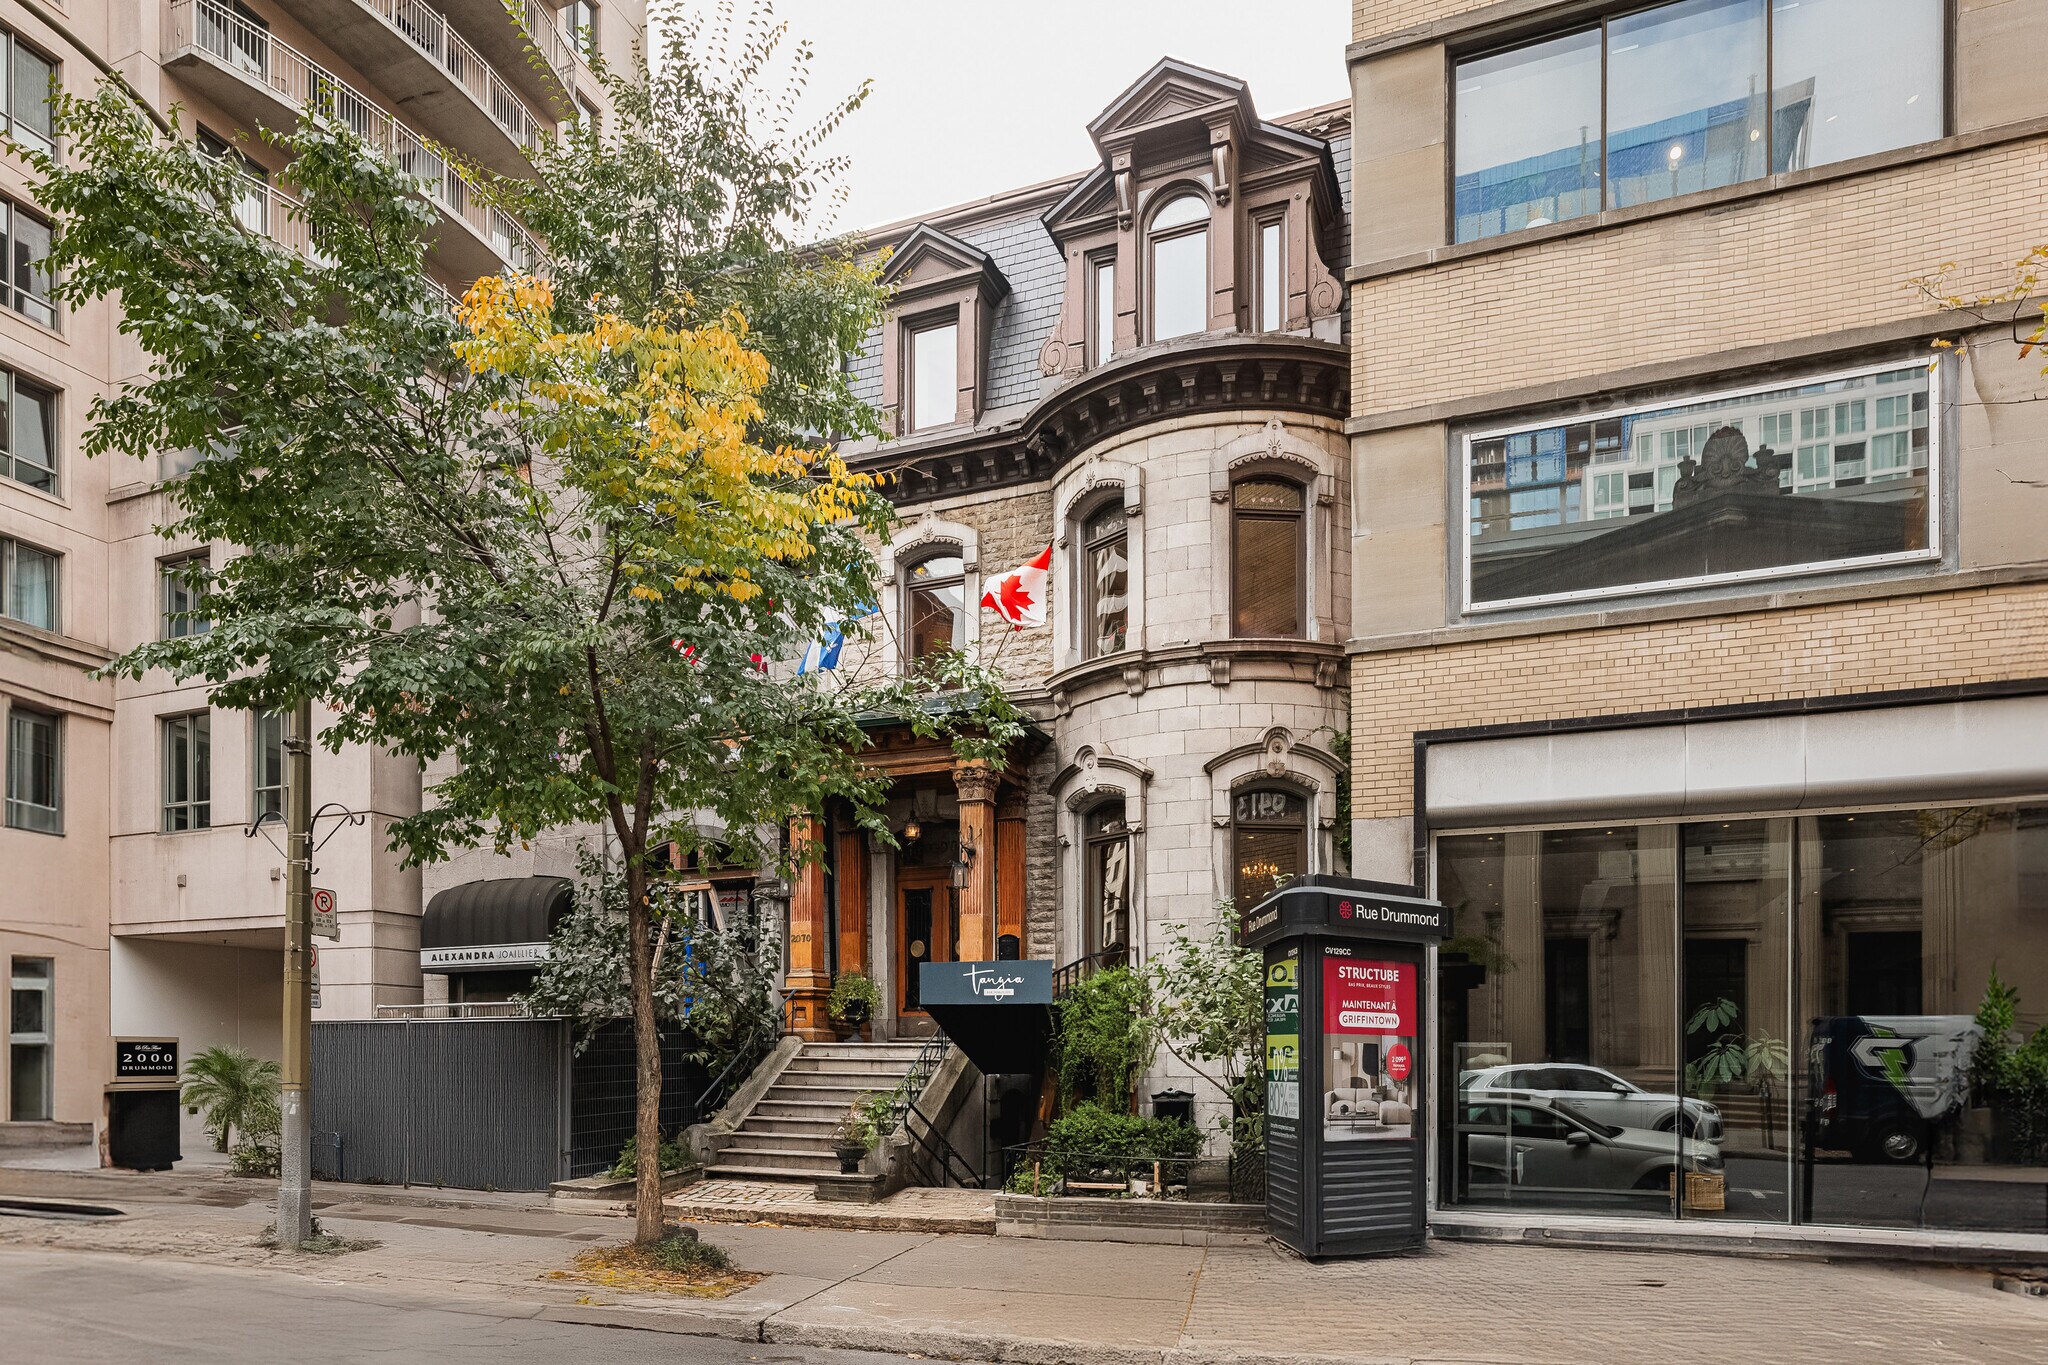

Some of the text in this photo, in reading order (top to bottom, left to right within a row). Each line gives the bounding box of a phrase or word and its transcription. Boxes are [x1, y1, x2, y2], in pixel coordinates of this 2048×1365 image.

[1356, 904, 1440, 927] Rue Drummond
[790, 934, 811, 943] 2070
[431, 948, 538, 962] ALEXANDRA JOAILLIER
[1324, 946, 1352, 956] CV129CC
[1338, 966, 1400, 982] STRUCTUBE
[1342, 1000, 1397, 1011] MAINTENANT À
[1342, 1014, 1398, 1025] GRIFFINTOWN
[123, 1053, 173, 1063] 2000
[1273, 1048, 1288, 1082] 0%
[1269, 1082, 1289, 1117] 80%
